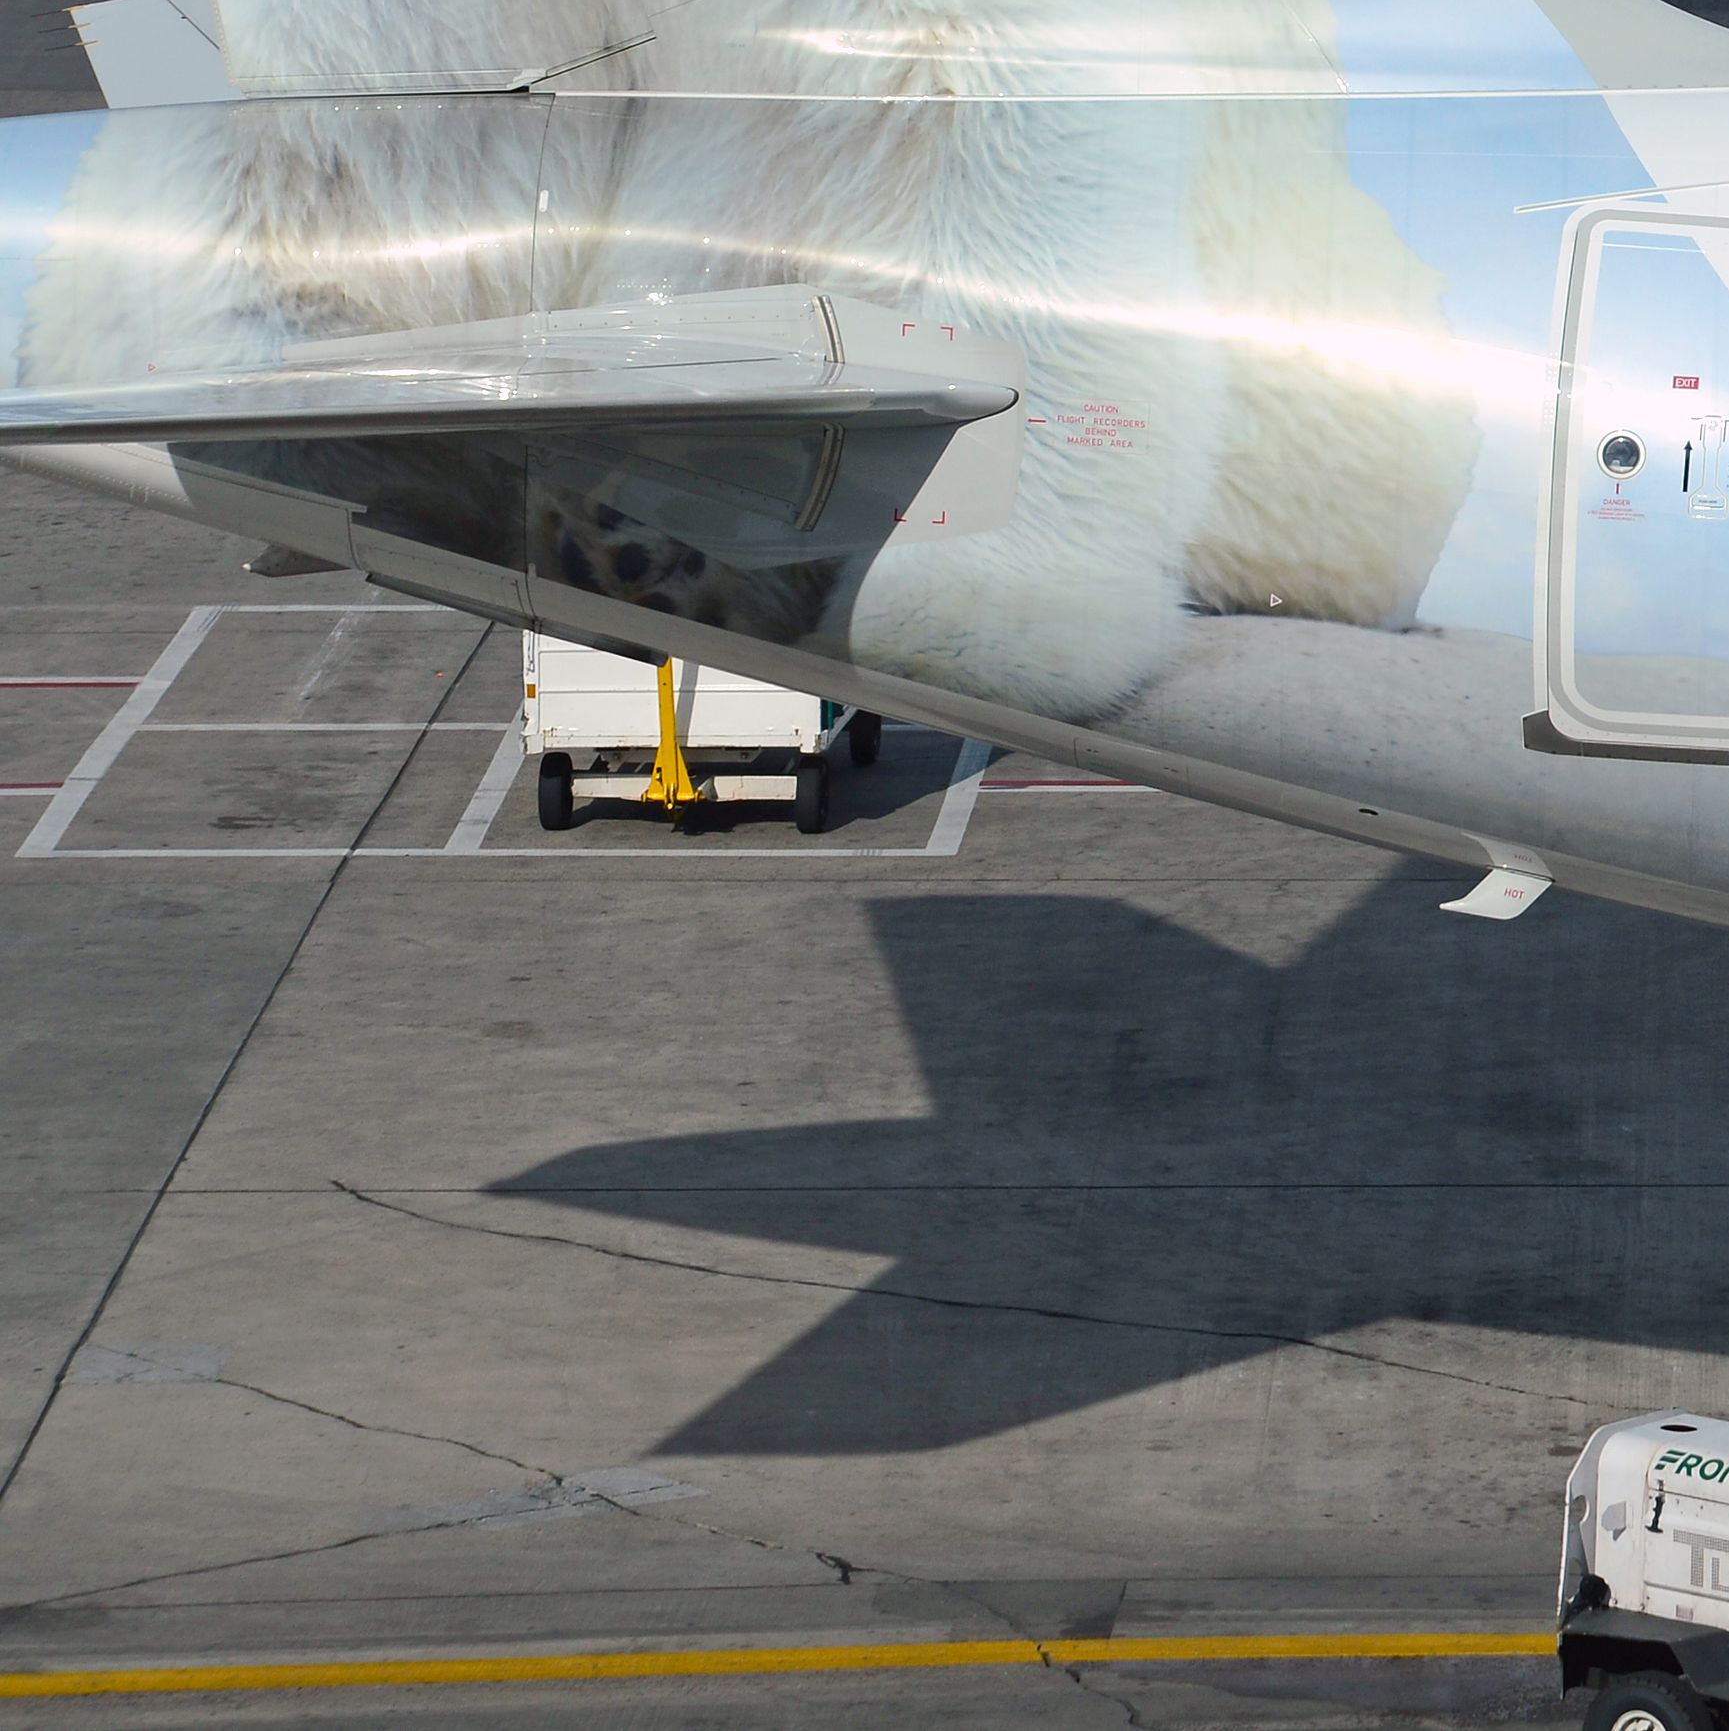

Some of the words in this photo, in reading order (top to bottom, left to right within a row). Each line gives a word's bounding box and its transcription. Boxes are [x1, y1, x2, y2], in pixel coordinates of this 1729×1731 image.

[1675, 377, 1696, 387] EXIT
[1084, 404, 1119, 413] CAUTION
[1057, 415, 1084, 424] FLIGHT
[1093, 418, 1145, 428] RECORDERS
[1085, 427, 1116, 437] BEHIND
[1067, 436, 1103, 446] MARKED
[1110, 440, 1133, 448] AREA
